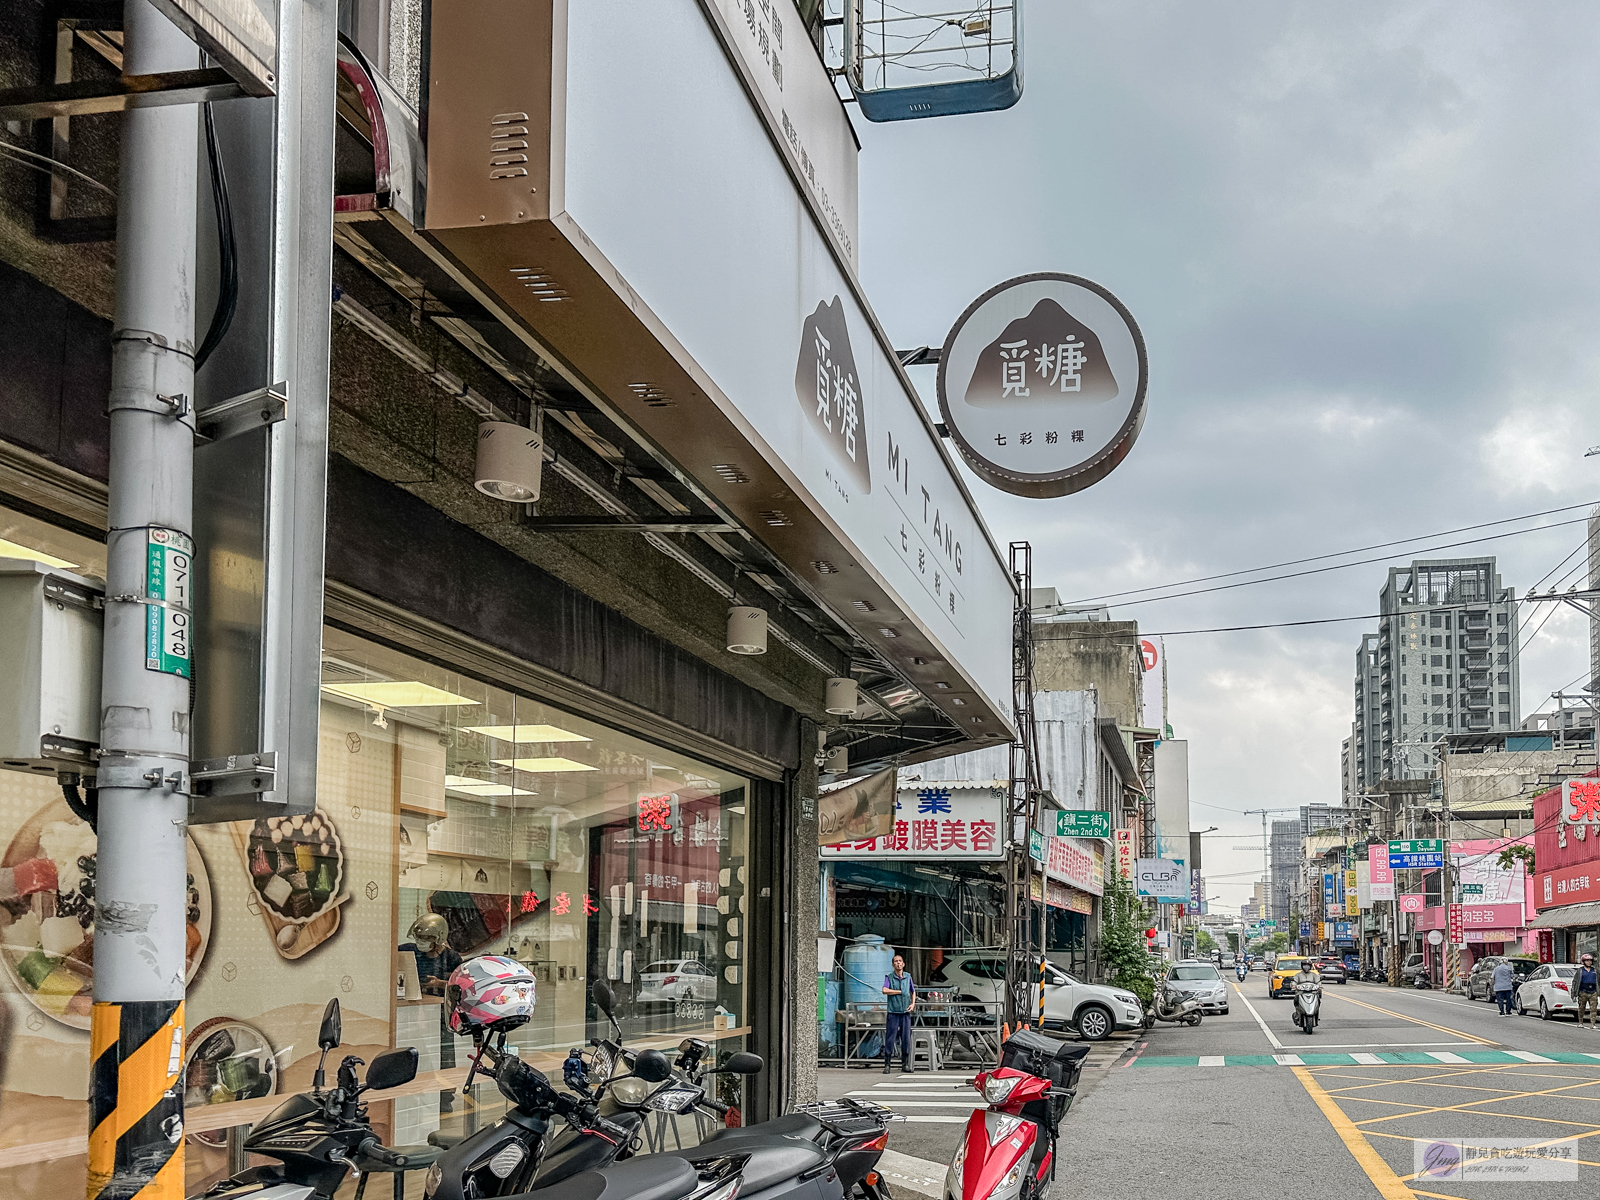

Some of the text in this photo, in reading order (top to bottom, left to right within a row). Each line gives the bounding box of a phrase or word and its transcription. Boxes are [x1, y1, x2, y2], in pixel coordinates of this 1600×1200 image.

[999, 334, 1088, 399] 覓糖
[814, 325, 859, 463] 覓糖
[994, 429, 1085, 446] 七彩粉粿
[887, 430, 963, 577] MI TANG
[1063, 813, 1104, 827] 鎮二街
[1063, 827, 1104, 837] Zhen 2nd St.
[1557, 875, 1590, 894] 台灣人的古早味
